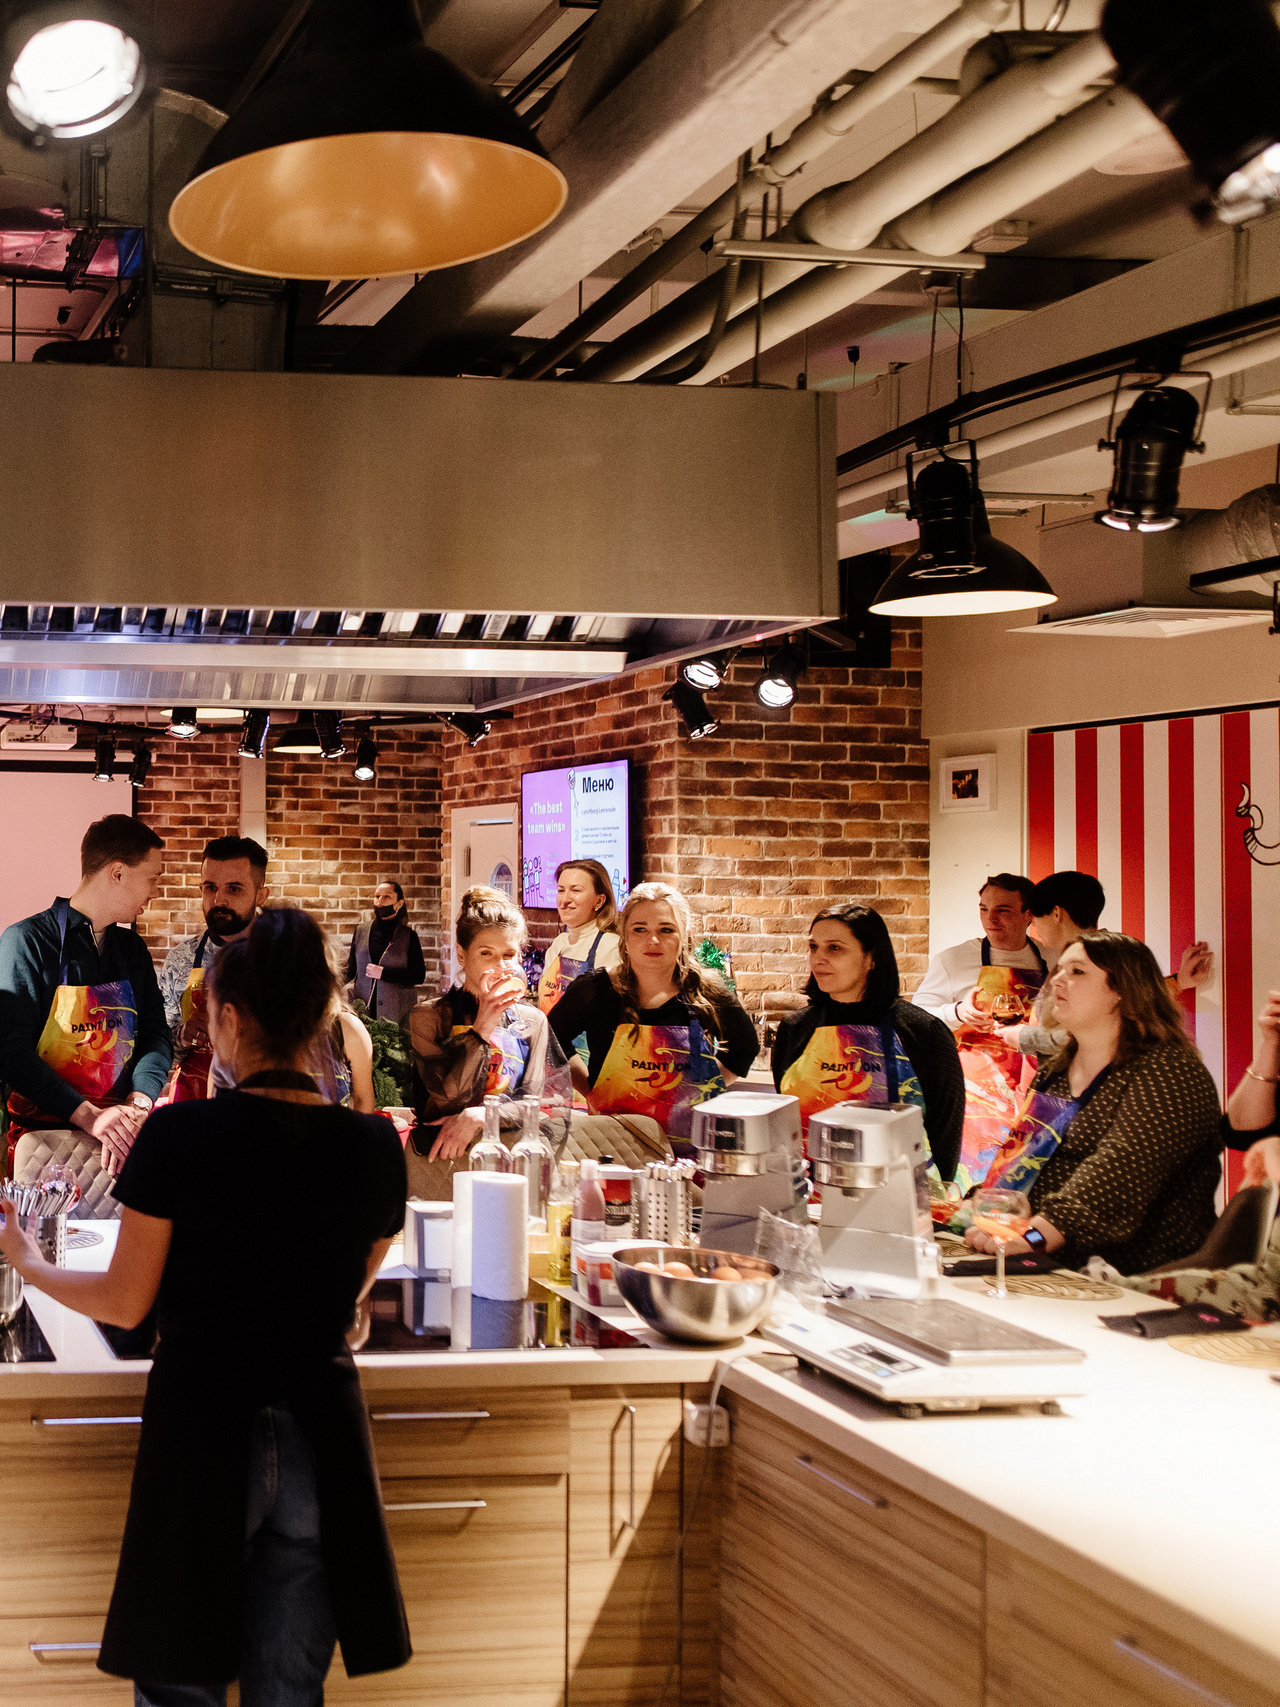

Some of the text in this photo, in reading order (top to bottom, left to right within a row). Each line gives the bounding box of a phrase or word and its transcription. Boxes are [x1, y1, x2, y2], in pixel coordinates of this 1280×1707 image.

[582, 776, 614, 794] Меню
[547, 800, 563, 814] best
[527, 822, 545, 834] team
[72, 1021, 102, 1033] PAINT
[631, 1060, 668, 1071] PAINT
[820, 1062, 856, 1072] PAINT
